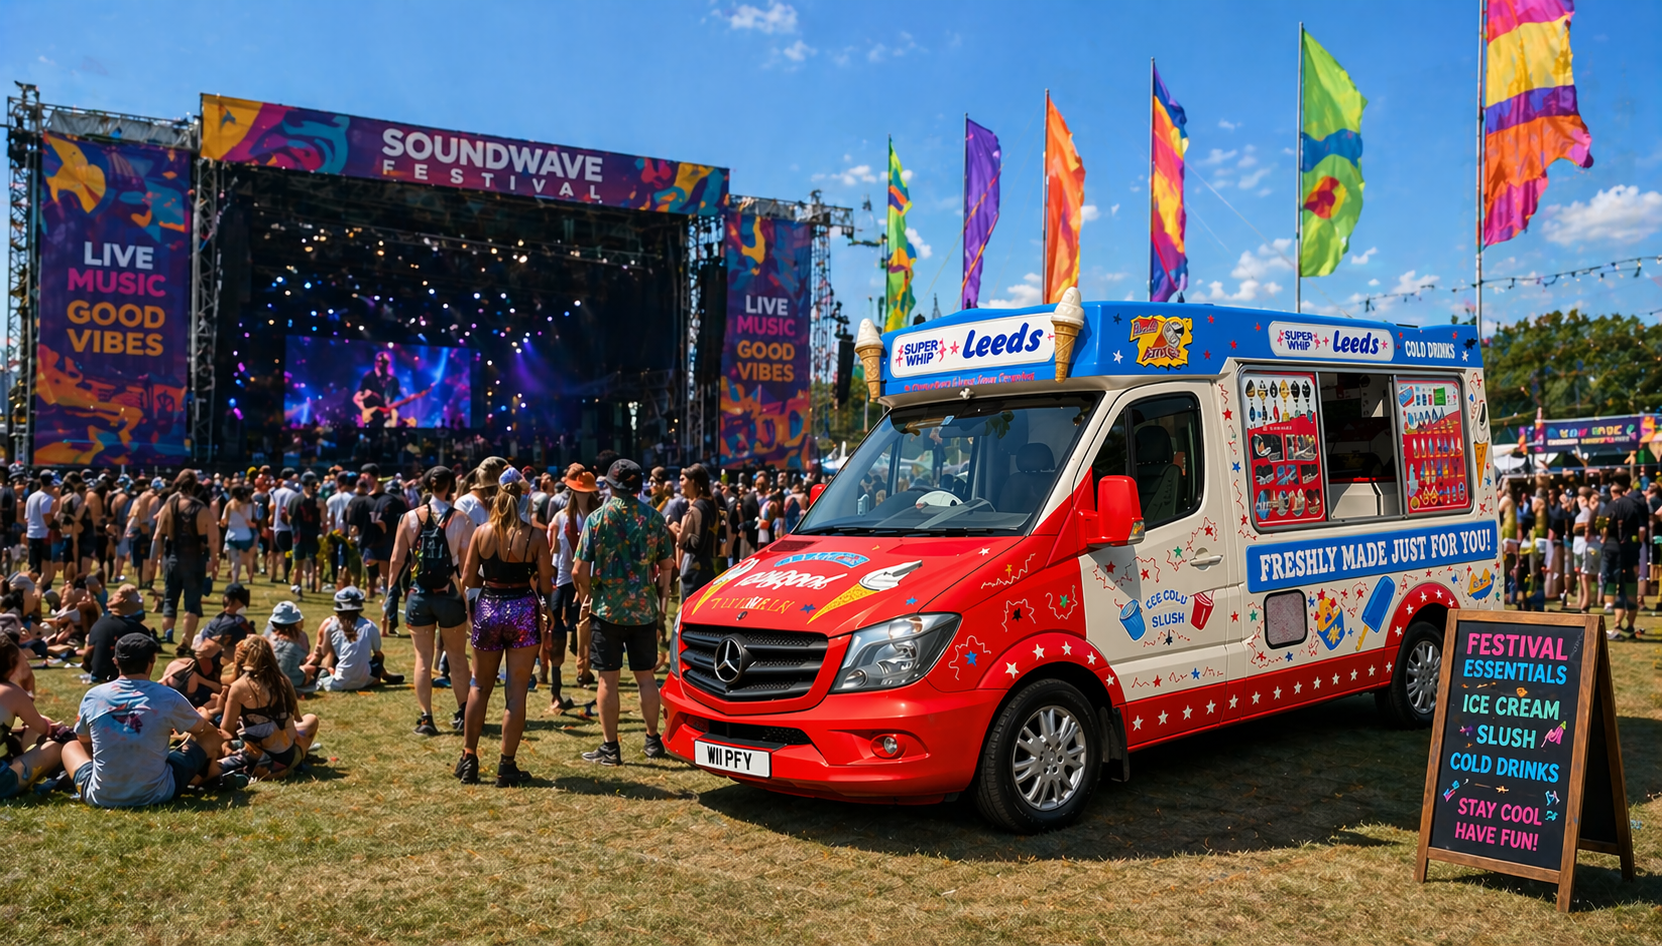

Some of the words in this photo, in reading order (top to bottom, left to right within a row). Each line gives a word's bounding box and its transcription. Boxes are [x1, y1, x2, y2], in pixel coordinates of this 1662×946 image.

[381, 128, 603, 182] SOUNDWAVE
[382, 159, 600, 199] FESTIVAL
[84, 241, 154, 270] LIVE
[67, 267, 166, 297] MUSIC
[67, 299, 165, 328] GOOD
[746, 295, 788, 316] LIVE
[737, 315, 795, 336] MUSIC
[1285, 330, 1313, 341] SUPER
[66, 329, 164, 356] VIBES
[737, 340, 795, 360] GOOD
[904, 339, 938, 355] SUPER
[962, 322, 1044, 359] Leeds
[1287, 340, 1311, 350] WHIP
[1333, 330, 1379, 354] Leeds
[1405, 340, 1426, 358] COLD
[737, 362, 794, 382] VIBES
[906, 352, 934, 366] WHIP
[1260, 546, 1337, 582] FRESHLY
[1341, 541, 1388, 570] MADE
[1392, 536, 1427, 564] JUST
[1431, 532, 1458, 558] FOR
[1460, 529, 1491, 554] YOU!
[1152, 612, 1184, 628] SLUSH
[1467, 632, 1568, 661] FESTIVAL
[1463, 659, 1567, 685] ESSENTIALS
[1463, 694, 1489, 714] ICE
[1496, 696, 1560, 720] CREAM
[1477, 725, 1536, 749] SLUSH
[725, 749, 752, 770] PFY
[1451, 752, 1492, 774] COLD
[1496, 757, 1559, 783] DRINKS
[1458, 798, 1497, 819] STAY
[1501, 803, 1542, 826] COOL
[1455, 822, 1495, 845] HAVE
[1501, 828, 1538, 851] FUN!
